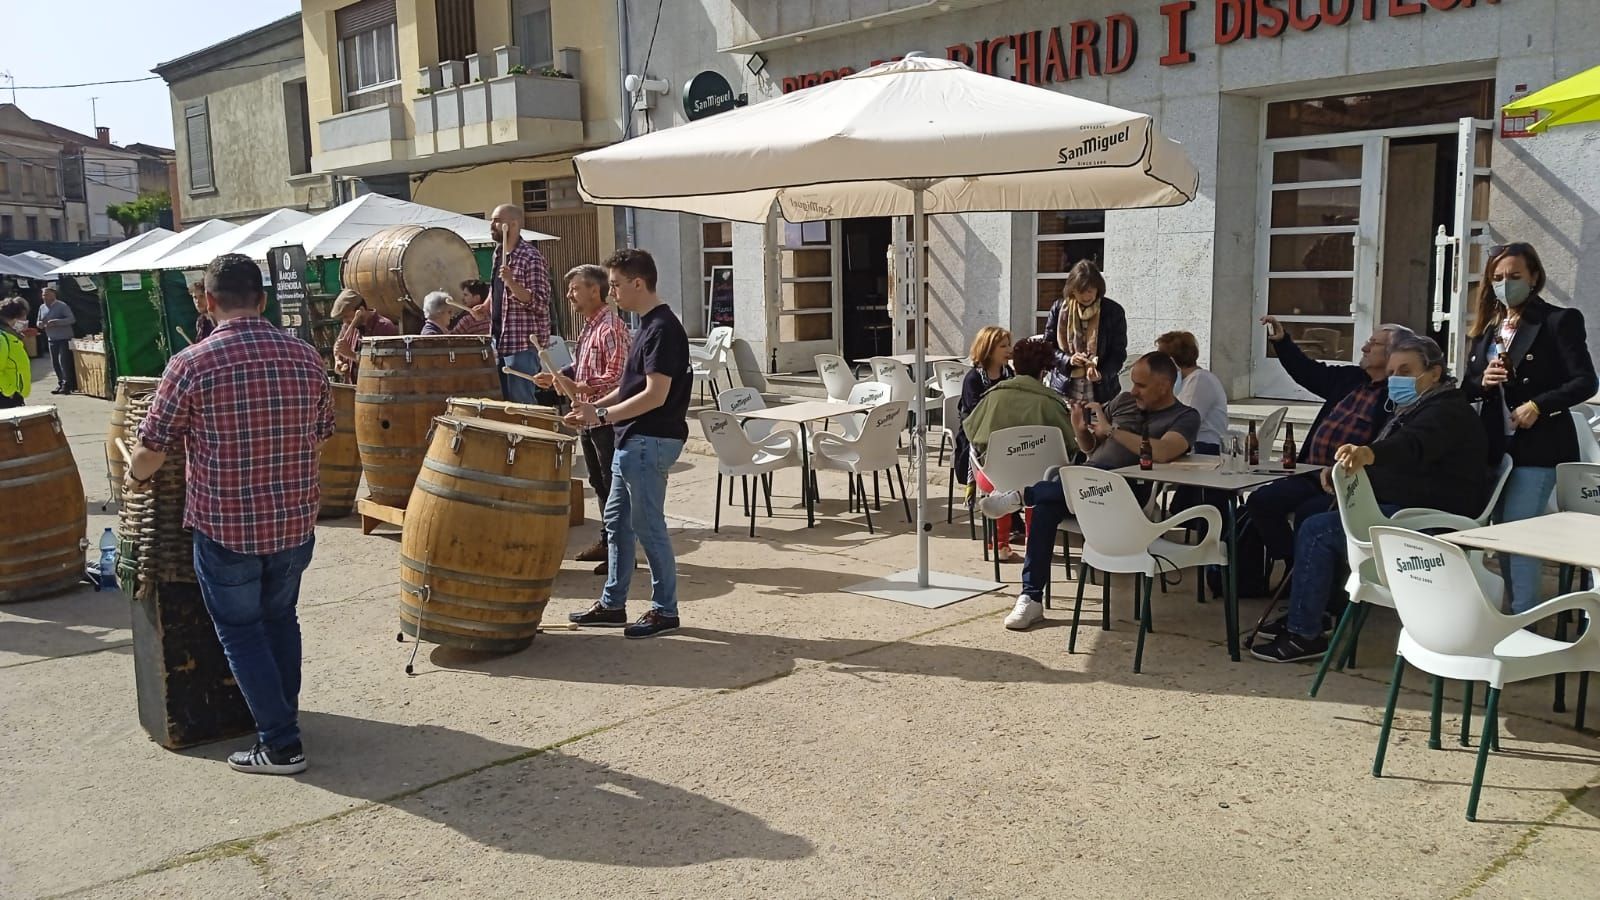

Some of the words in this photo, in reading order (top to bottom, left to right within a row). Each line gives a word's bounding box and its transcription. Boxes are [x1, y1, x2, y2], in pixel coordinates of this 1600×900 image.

[1160, 1, 1195, 66] I
[693, 90, 731, 112] SanMiguel
[1057, 126, 1129, 164] SanMiguel
[1006, 434, 1047, 456] SanMiguel
[1396, 552, 1446, 573] SanMiguel
